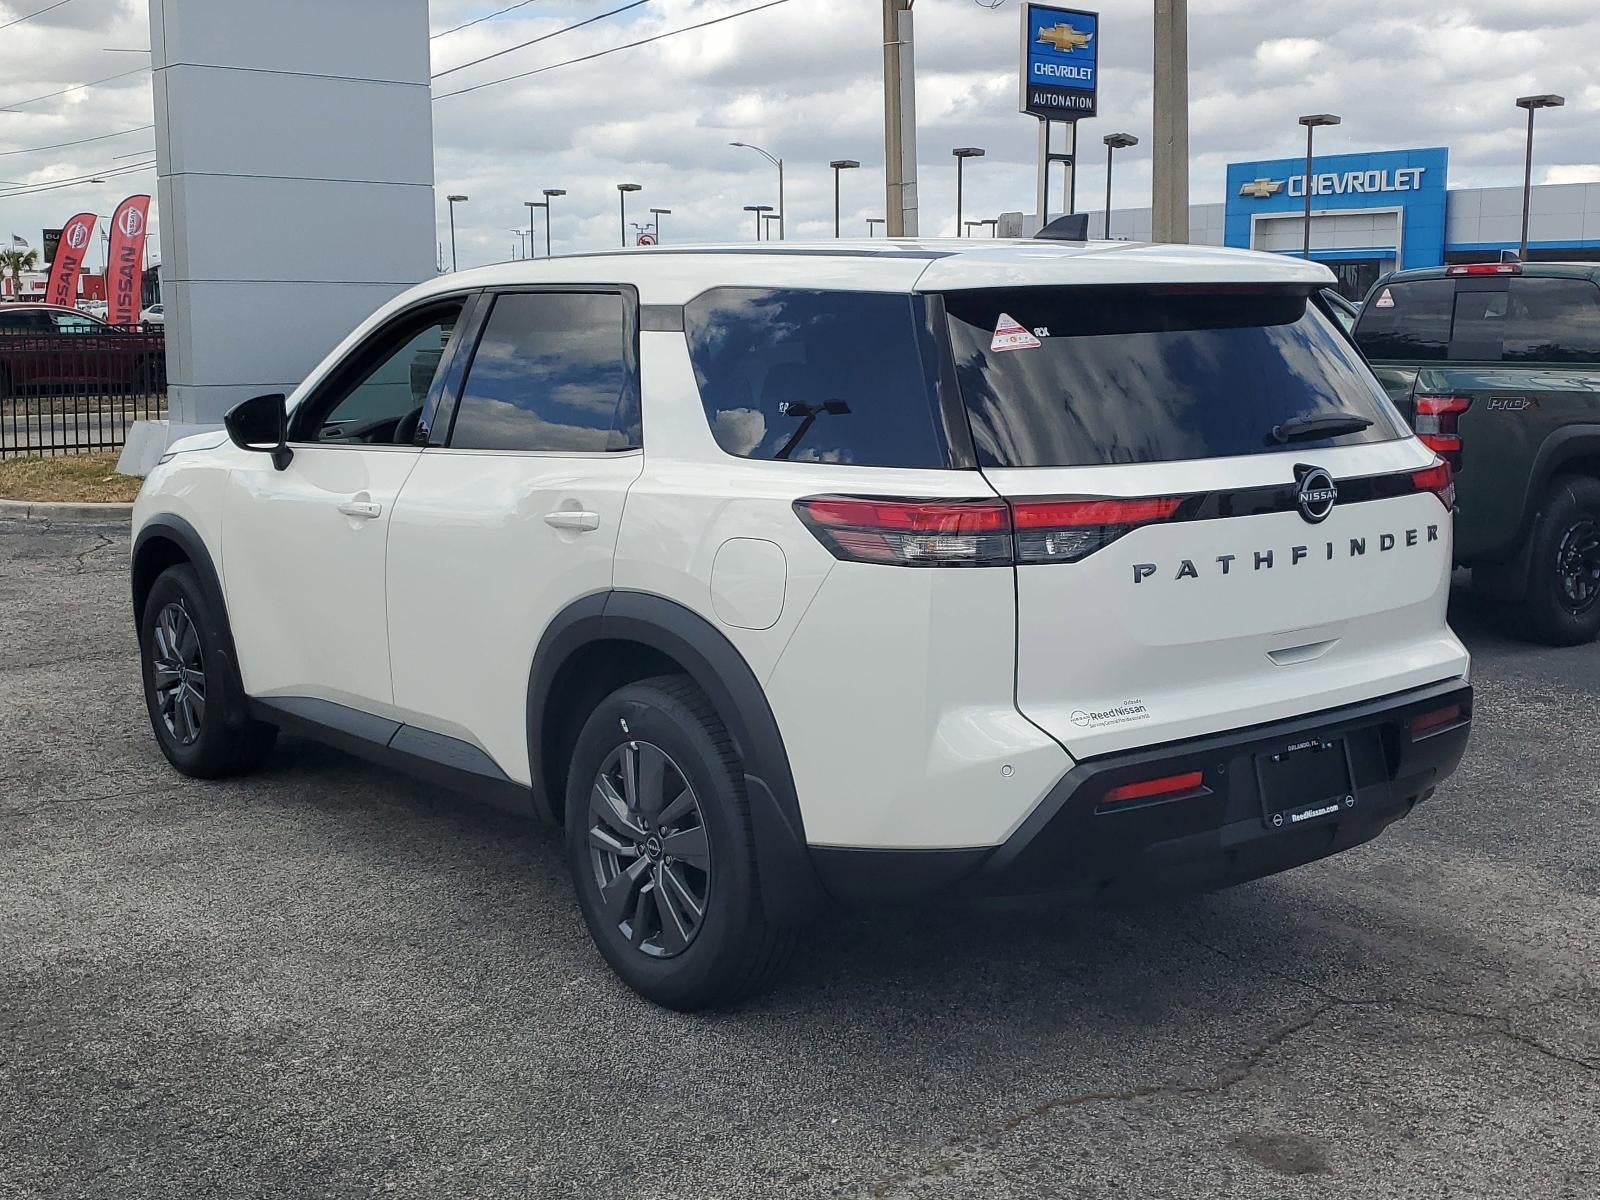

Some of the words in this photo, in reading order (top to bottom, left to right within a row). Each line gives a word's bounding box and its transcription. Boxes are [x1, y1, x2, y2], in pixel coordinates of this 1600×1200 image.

[1034, 62, 1093, 80] CHEVROLET
[1033, 92, 1093, 108] AUTONATION
[1287, 167, 1425, 197] CHEVROLET
[127, 208, 136, 236] NISSAN
[55, 255, 78, 306] SSAN
[1300, 490, 1338, 502] NISSAN
[1132, 524, 1439, 584] PATHFINDER
[1292, 805, 1339, 822] ReedNissan.com
